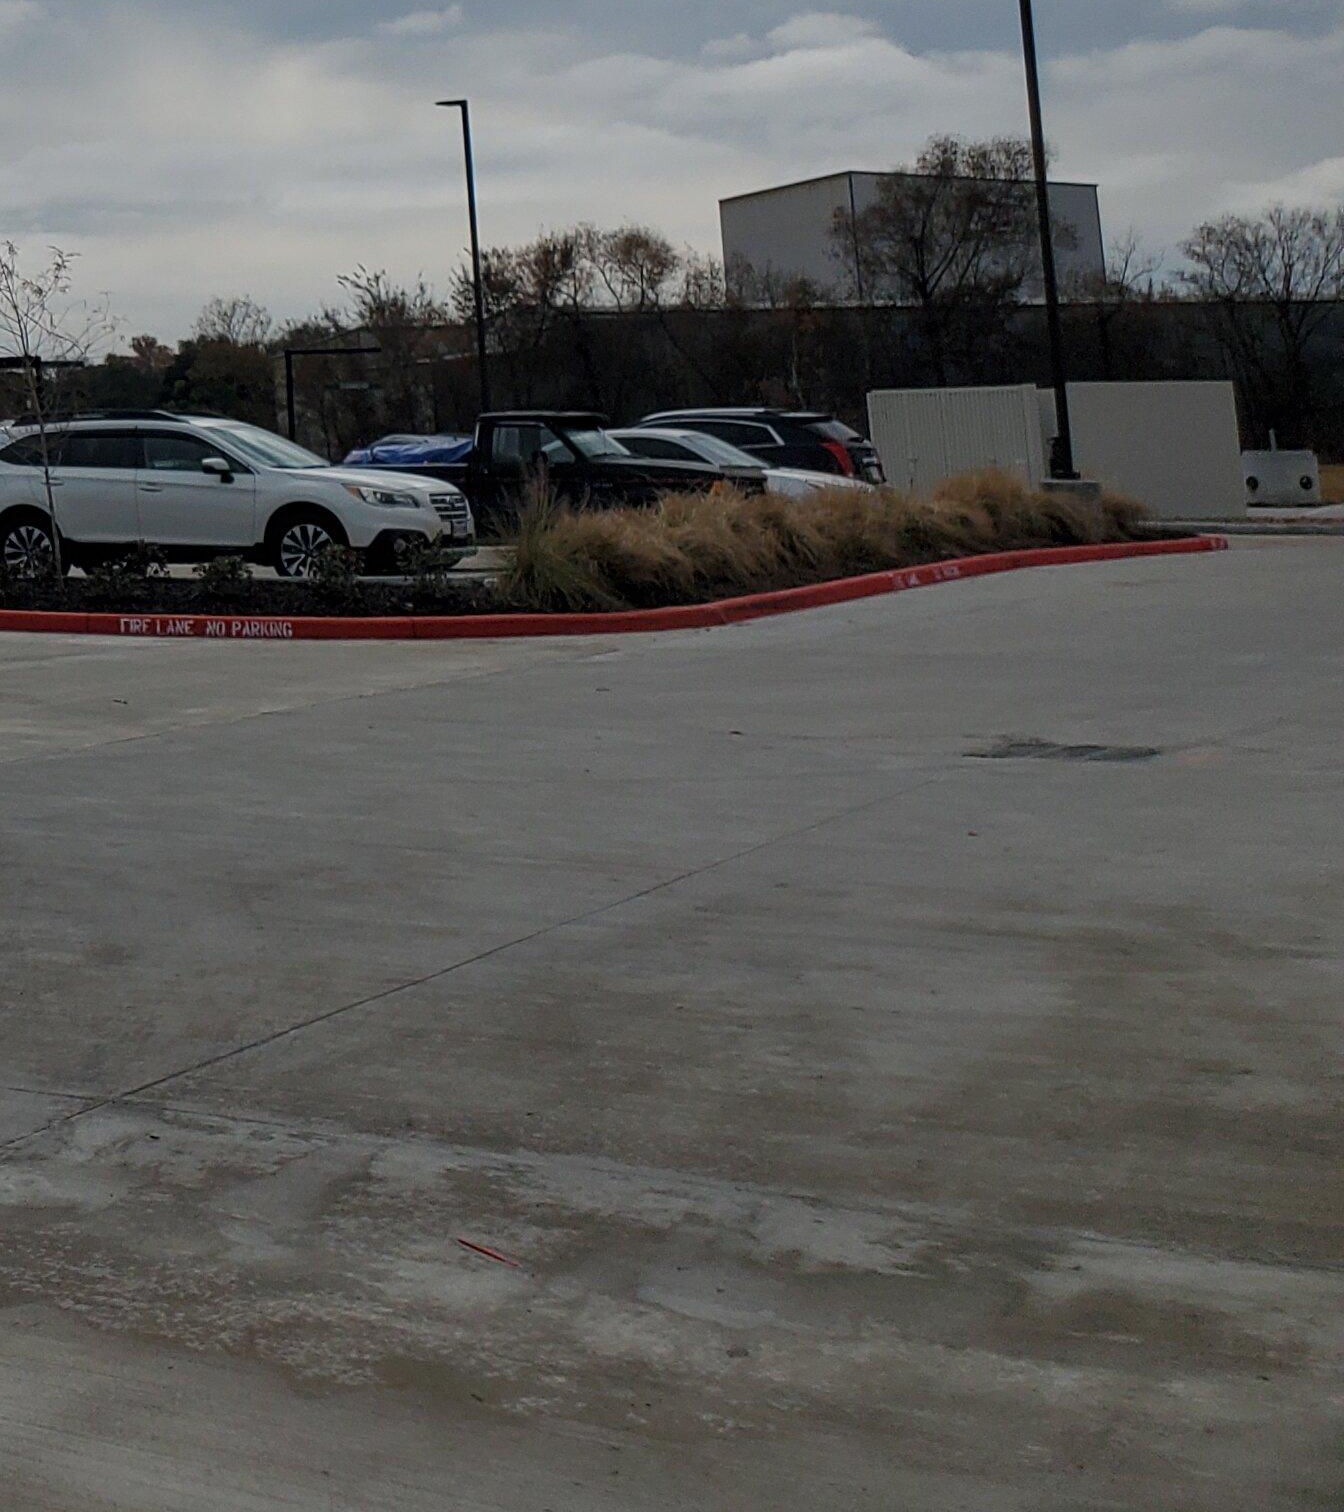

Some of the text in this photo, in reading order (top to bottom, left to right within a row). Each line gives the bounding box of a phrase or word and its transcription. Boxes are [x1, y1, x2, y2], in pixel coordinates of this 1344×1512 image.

[119, 617, 293, 638] FIRE LANE NO PARKING
